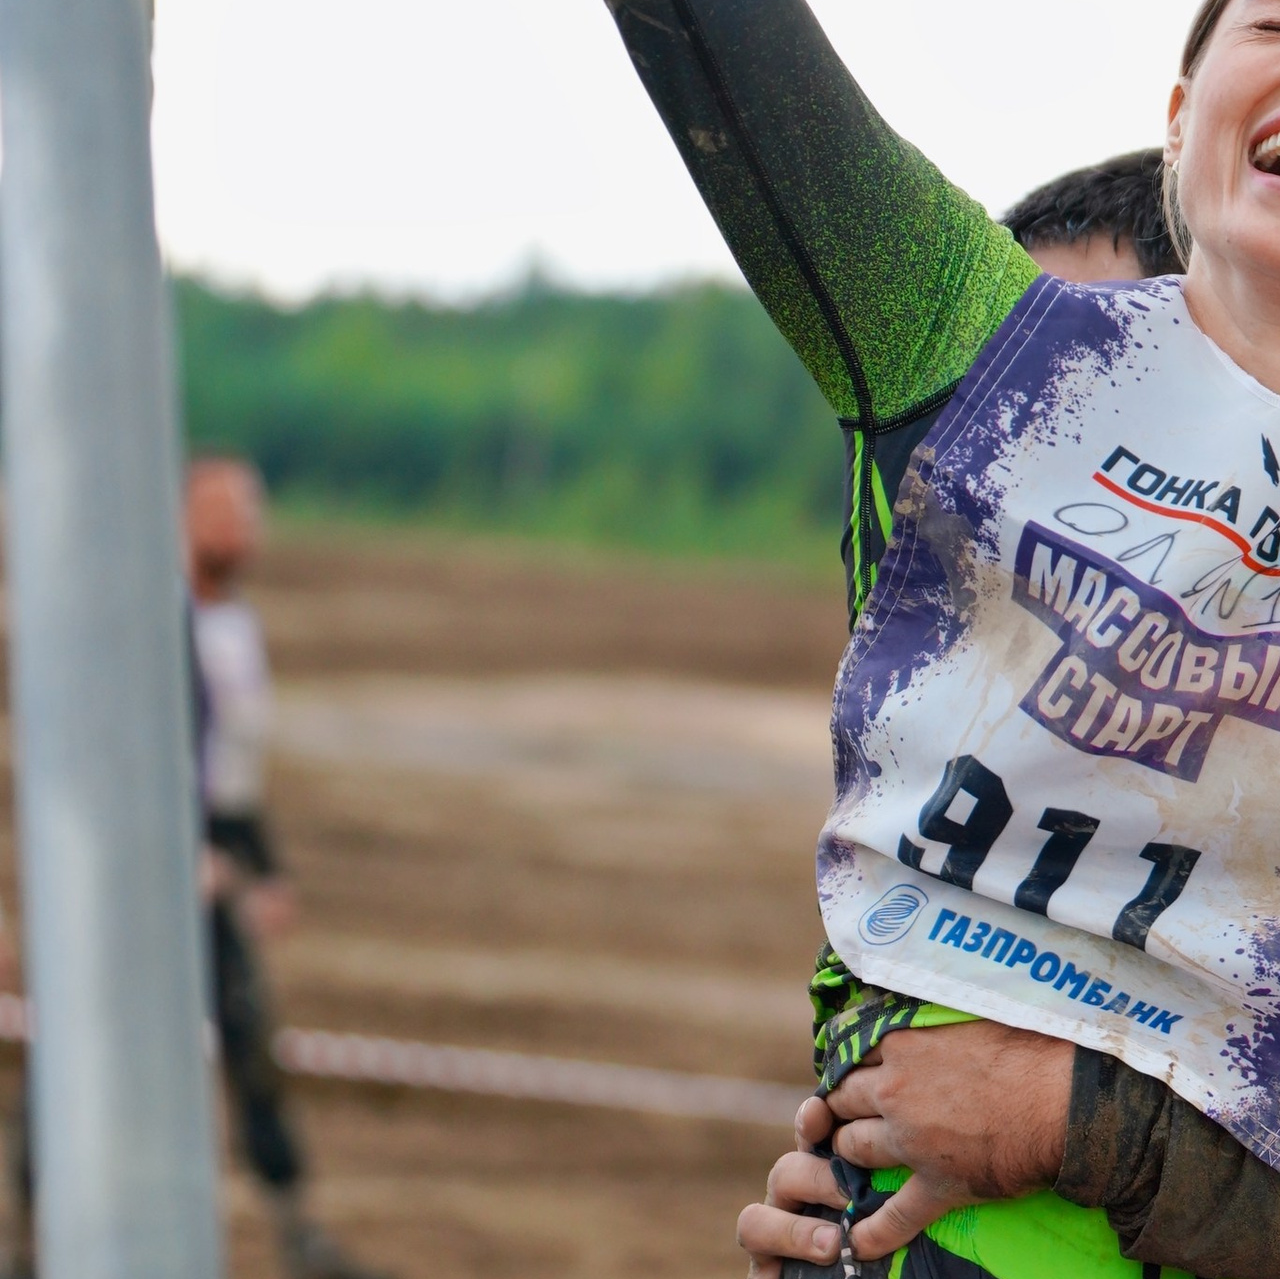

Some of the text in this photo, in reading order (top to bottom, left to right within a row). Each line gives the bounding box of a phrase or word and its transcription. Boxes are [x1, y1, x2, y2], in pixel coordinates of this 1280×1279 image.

[1101, 445, 1242, 524] ГОНКА
[1037, 656, 1213, 766] СТАРТ
[897, 754, 1202, 952] 911
[928, 908, 1185, 1034] ГАЗПРОМБАНК
